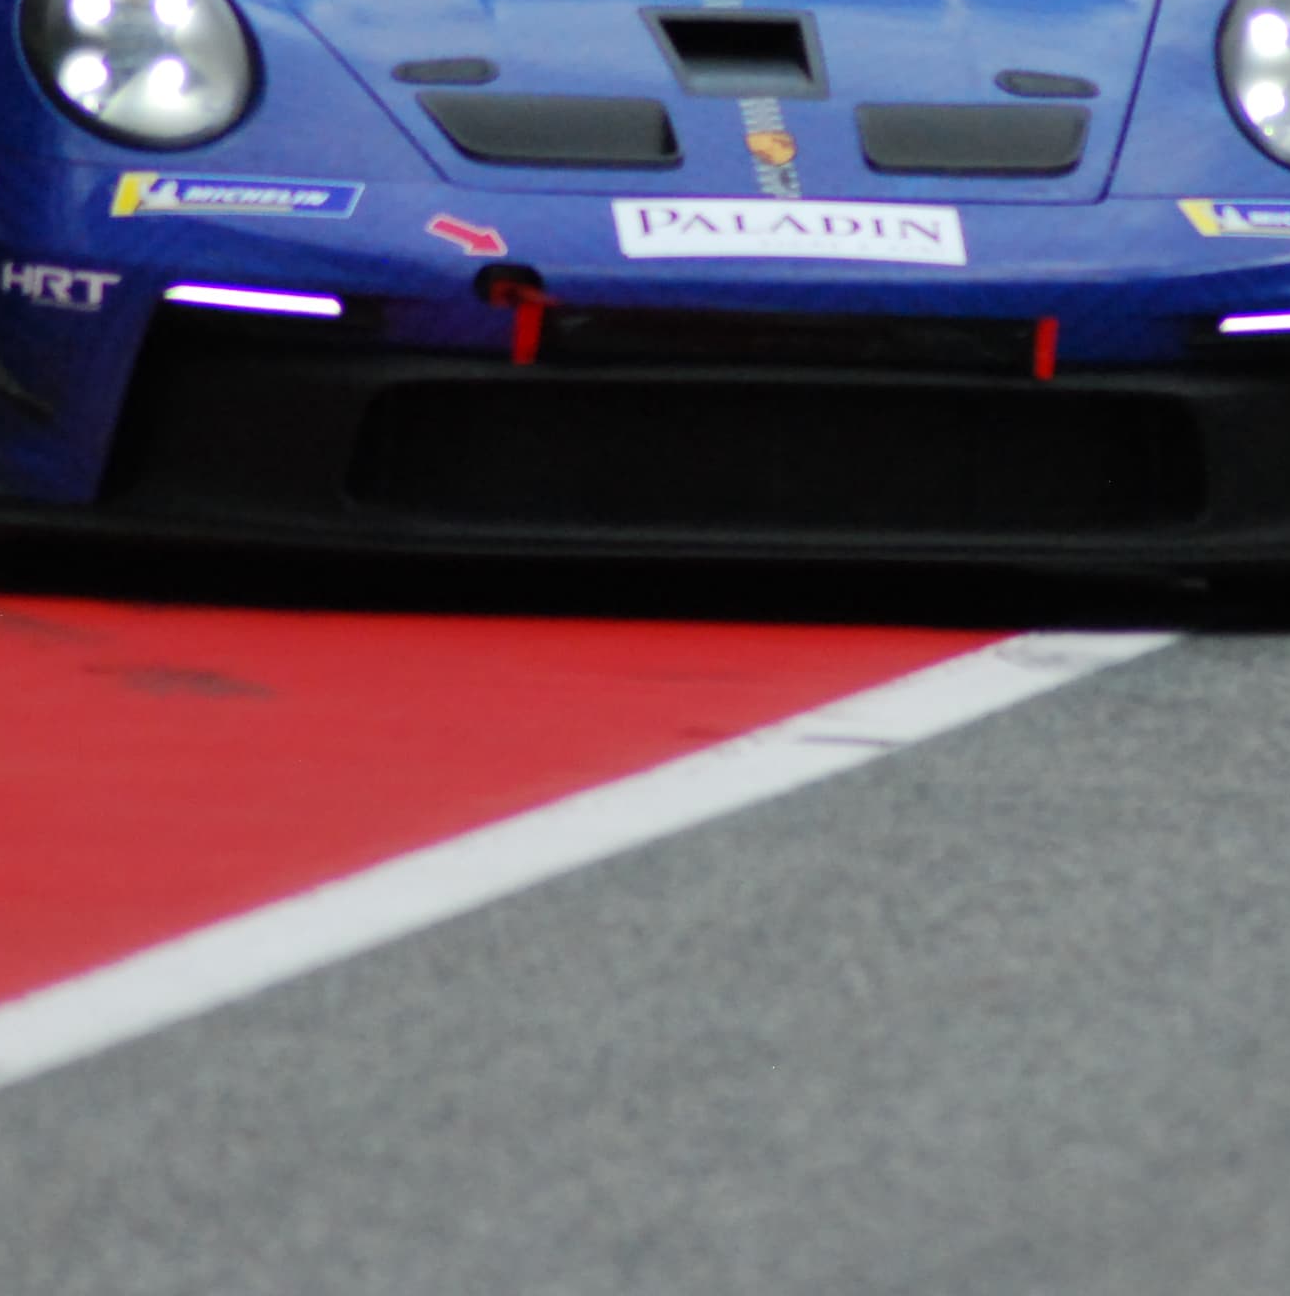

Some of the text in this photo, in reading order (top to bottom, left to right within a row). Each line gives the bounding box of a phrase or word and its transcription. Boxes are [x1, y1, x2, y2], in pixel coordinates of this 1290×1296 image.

[183, 186, 330, 207] MICHELIN
[639, 208, 941, 243] PALADIN
[2, 262, 122, 305] HRT
